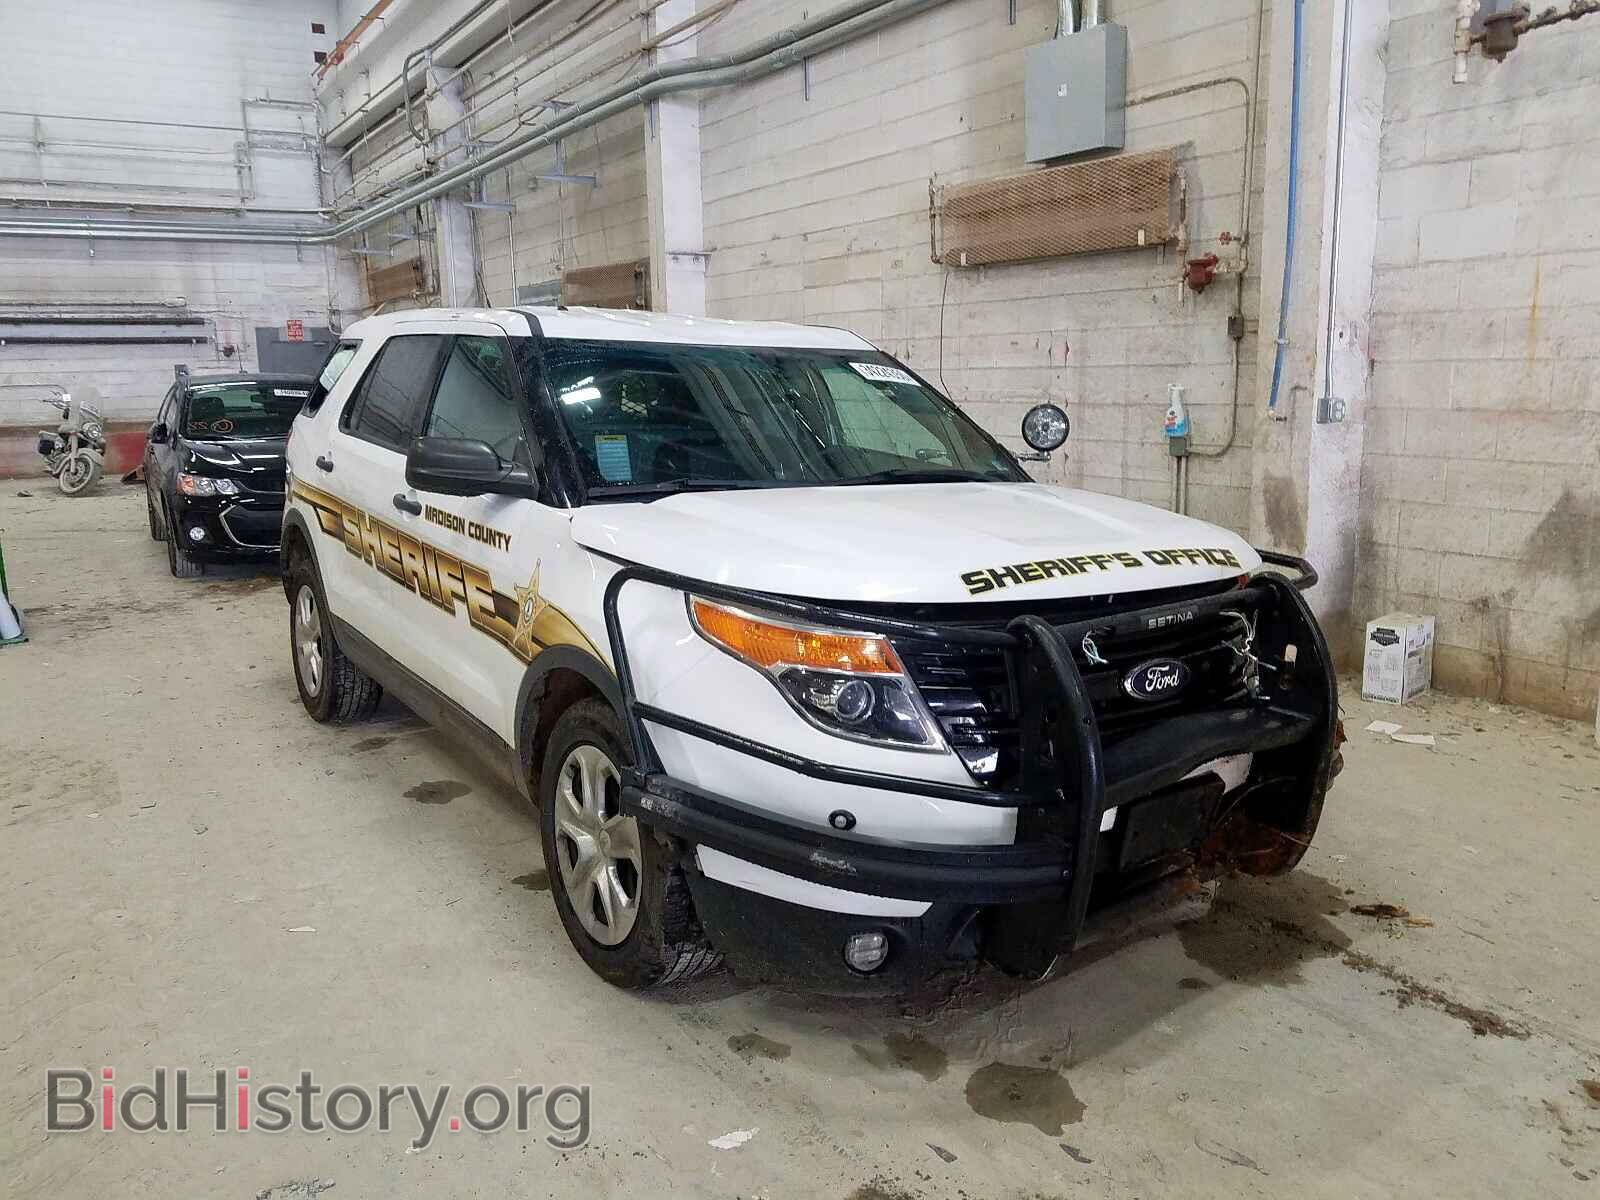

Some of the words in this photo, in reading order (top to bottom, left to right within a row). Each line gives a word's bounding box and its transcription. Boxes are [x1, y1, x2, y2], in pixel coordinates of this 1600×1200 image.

[425, 504, 466, 536] MADISON
[468, 521, 512, 552] COUNTY
[341, 503, 497, 629] SHERIFF
[960, 551, 1143, 595] SHERIFF'S
[1141, 548, 1242, 569] OFFICE
[1148, 610, 1194, 630] SETINA
[1145, 665, 1180, 692] Ford
